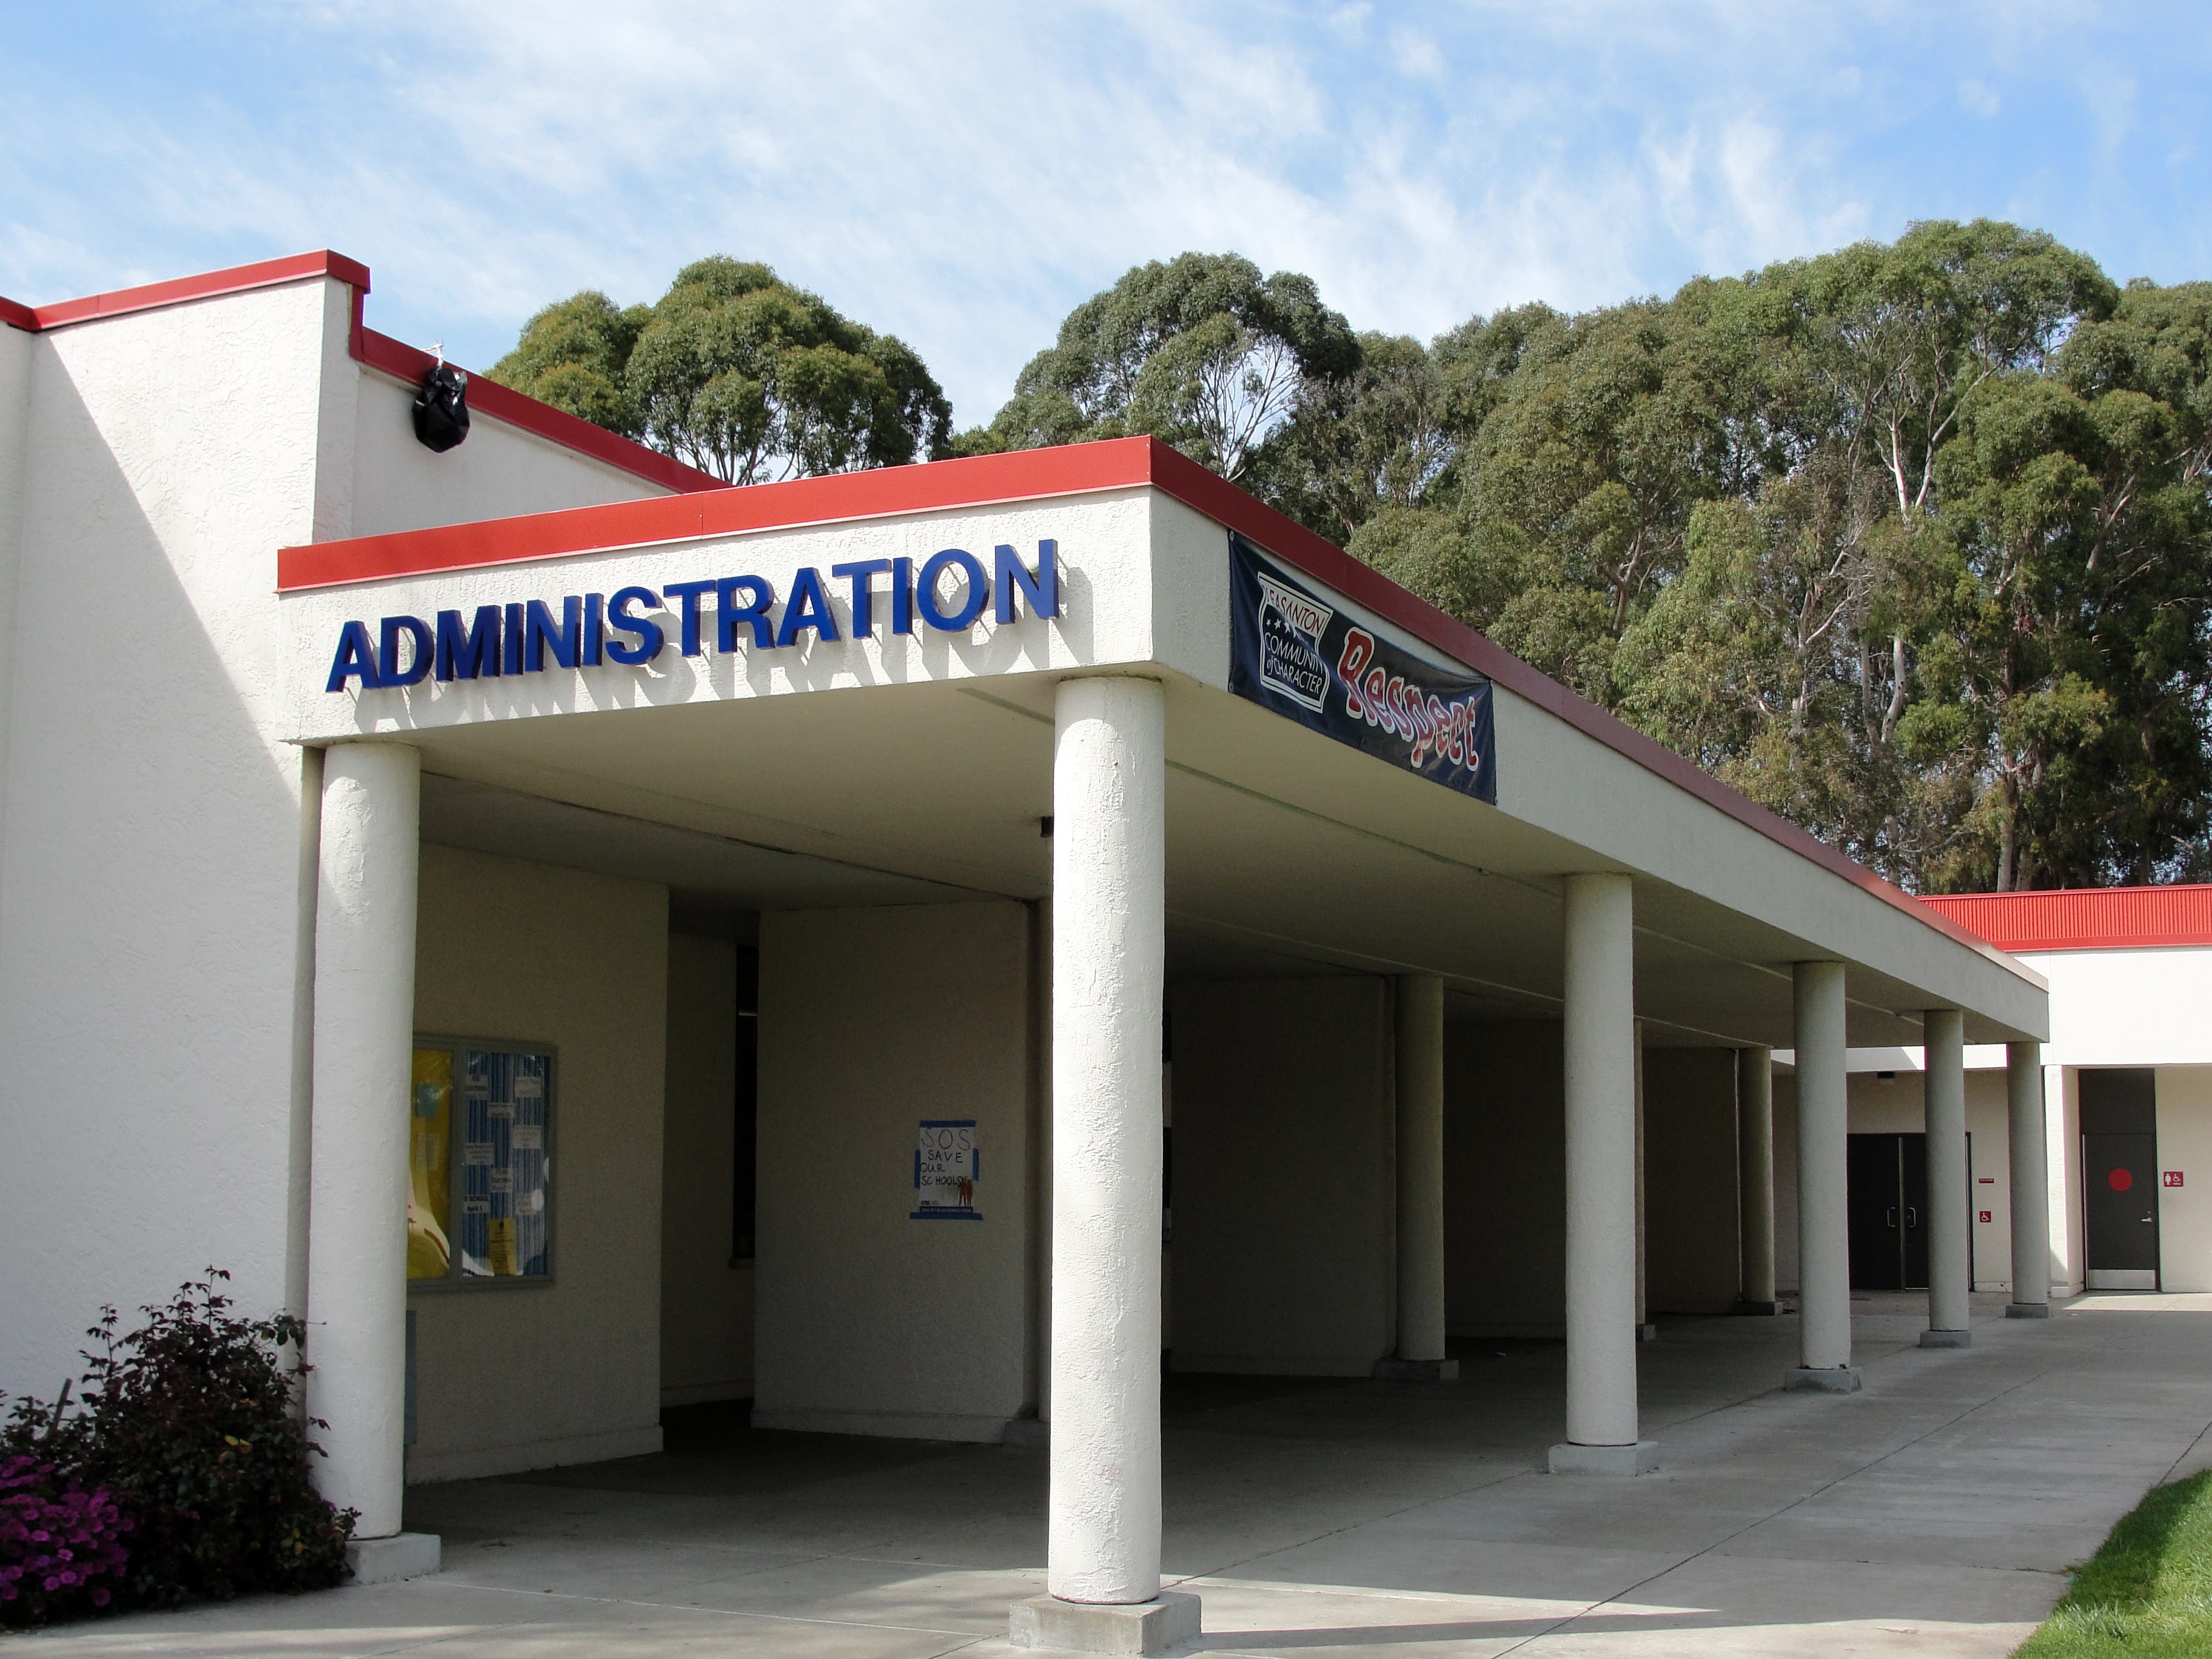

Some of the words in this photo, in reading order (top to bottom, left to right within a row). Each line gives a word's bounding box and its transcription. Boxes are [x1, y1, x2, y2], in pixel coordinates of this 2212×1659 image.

[325, 538, 1059, 693] ADMINISTRATION
[1262, 585, 1324, 634] LEASANTON
[1266, 655, 1273, 675] of
[1272, 657, 1322, 694] CHARACTER
[1338, 626, 1479, 771] Respect
[920, 1162, 945, 1173] OUR
[928, 1150, 964, 1163] SAVE
